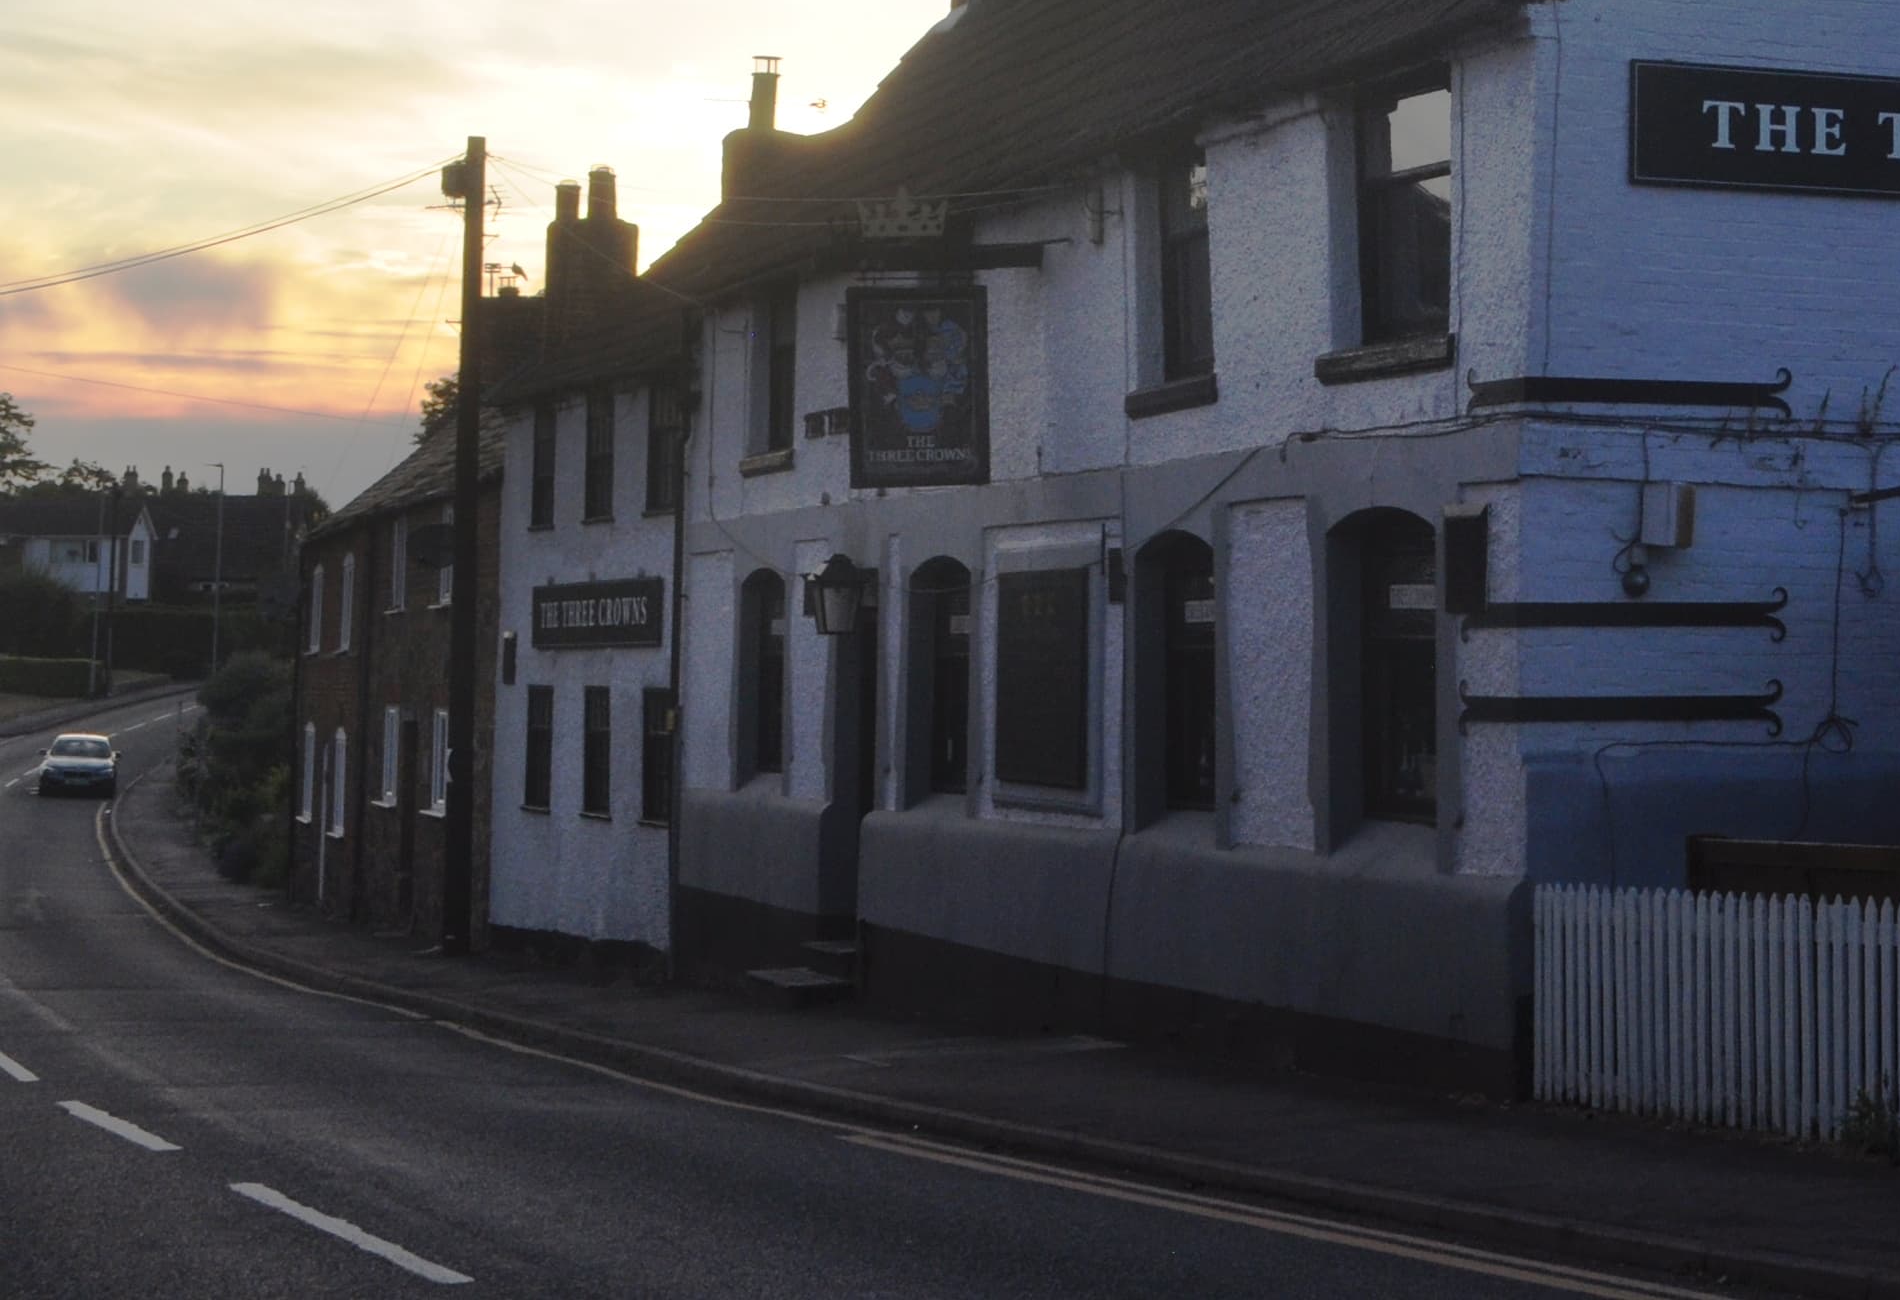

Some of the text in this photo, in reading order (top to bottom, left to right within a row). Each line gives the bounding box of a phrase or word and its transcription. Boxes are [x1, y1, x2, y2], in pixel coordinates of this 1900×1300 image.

[1703, 99, 1848, 157] THE
[906, 435, 936, 448] THE
[868, 449, 914, 462] THREE
[540, 596, 648, 629] THE THREE CROWNS
